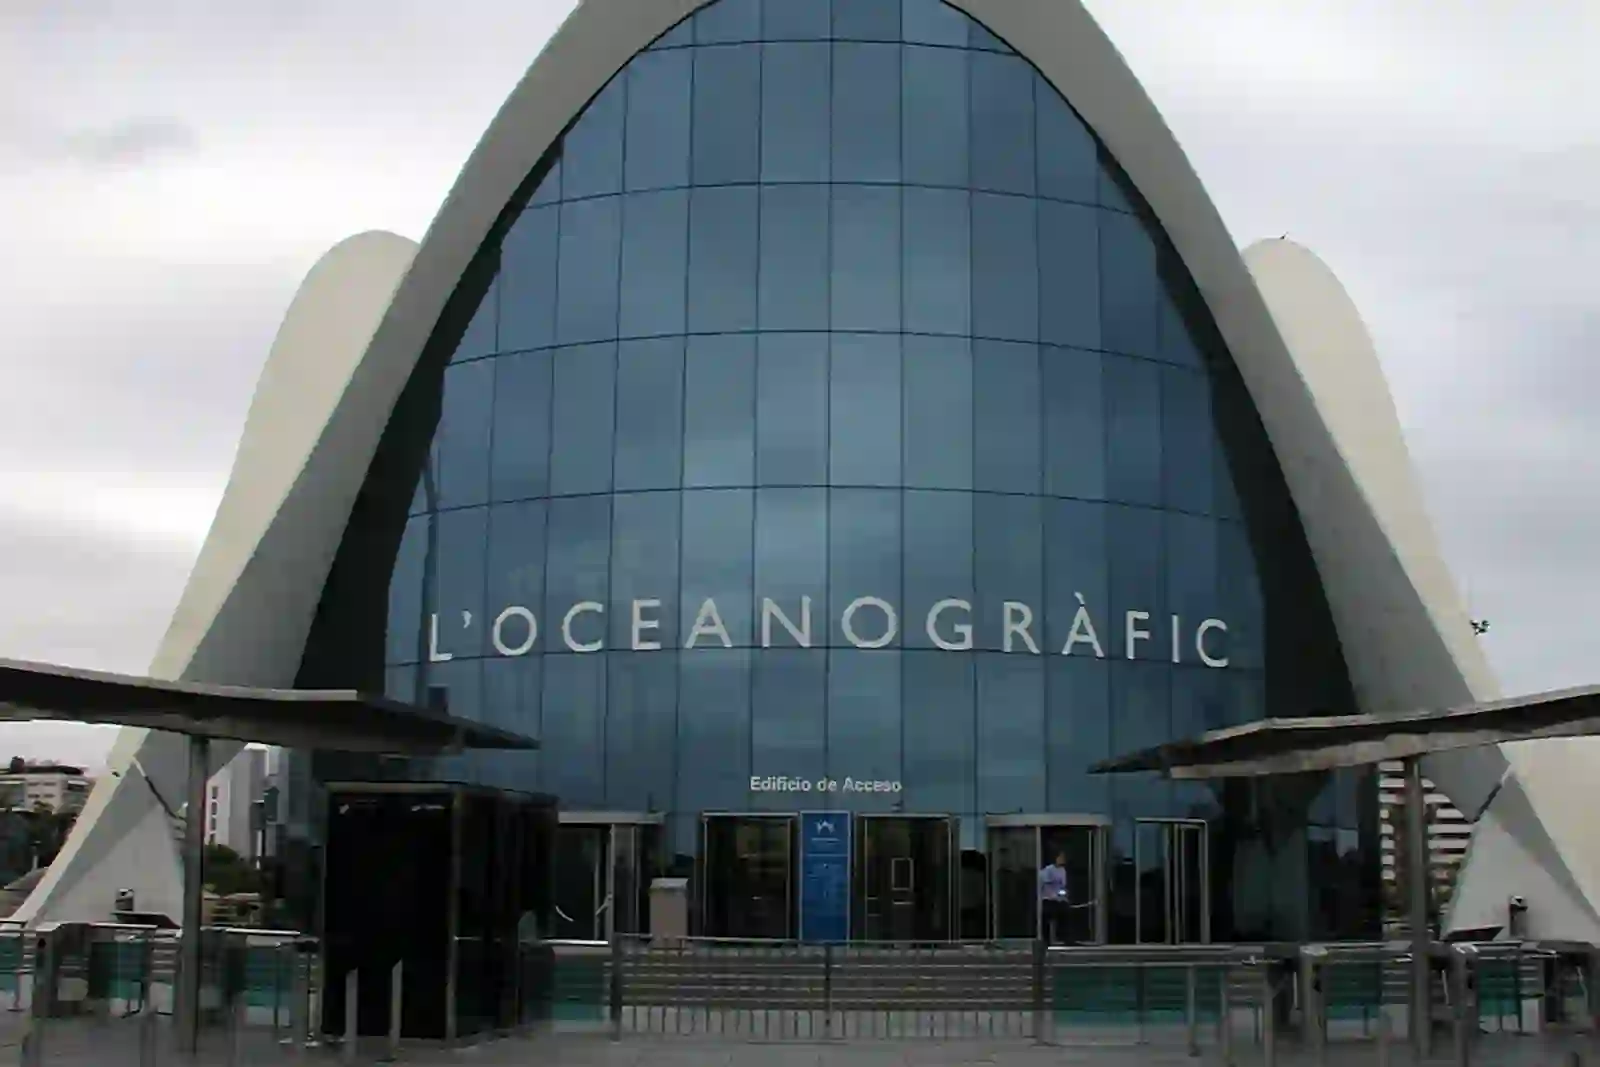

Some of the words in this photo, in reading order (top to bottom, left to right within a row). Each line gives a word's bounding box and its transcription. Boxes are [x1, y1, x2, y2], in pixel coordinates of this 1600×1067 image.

[750, 776, 811, 791] Edificio
[817, 776, 837, 791] de
[842, 777, 902, 792] Acceso
